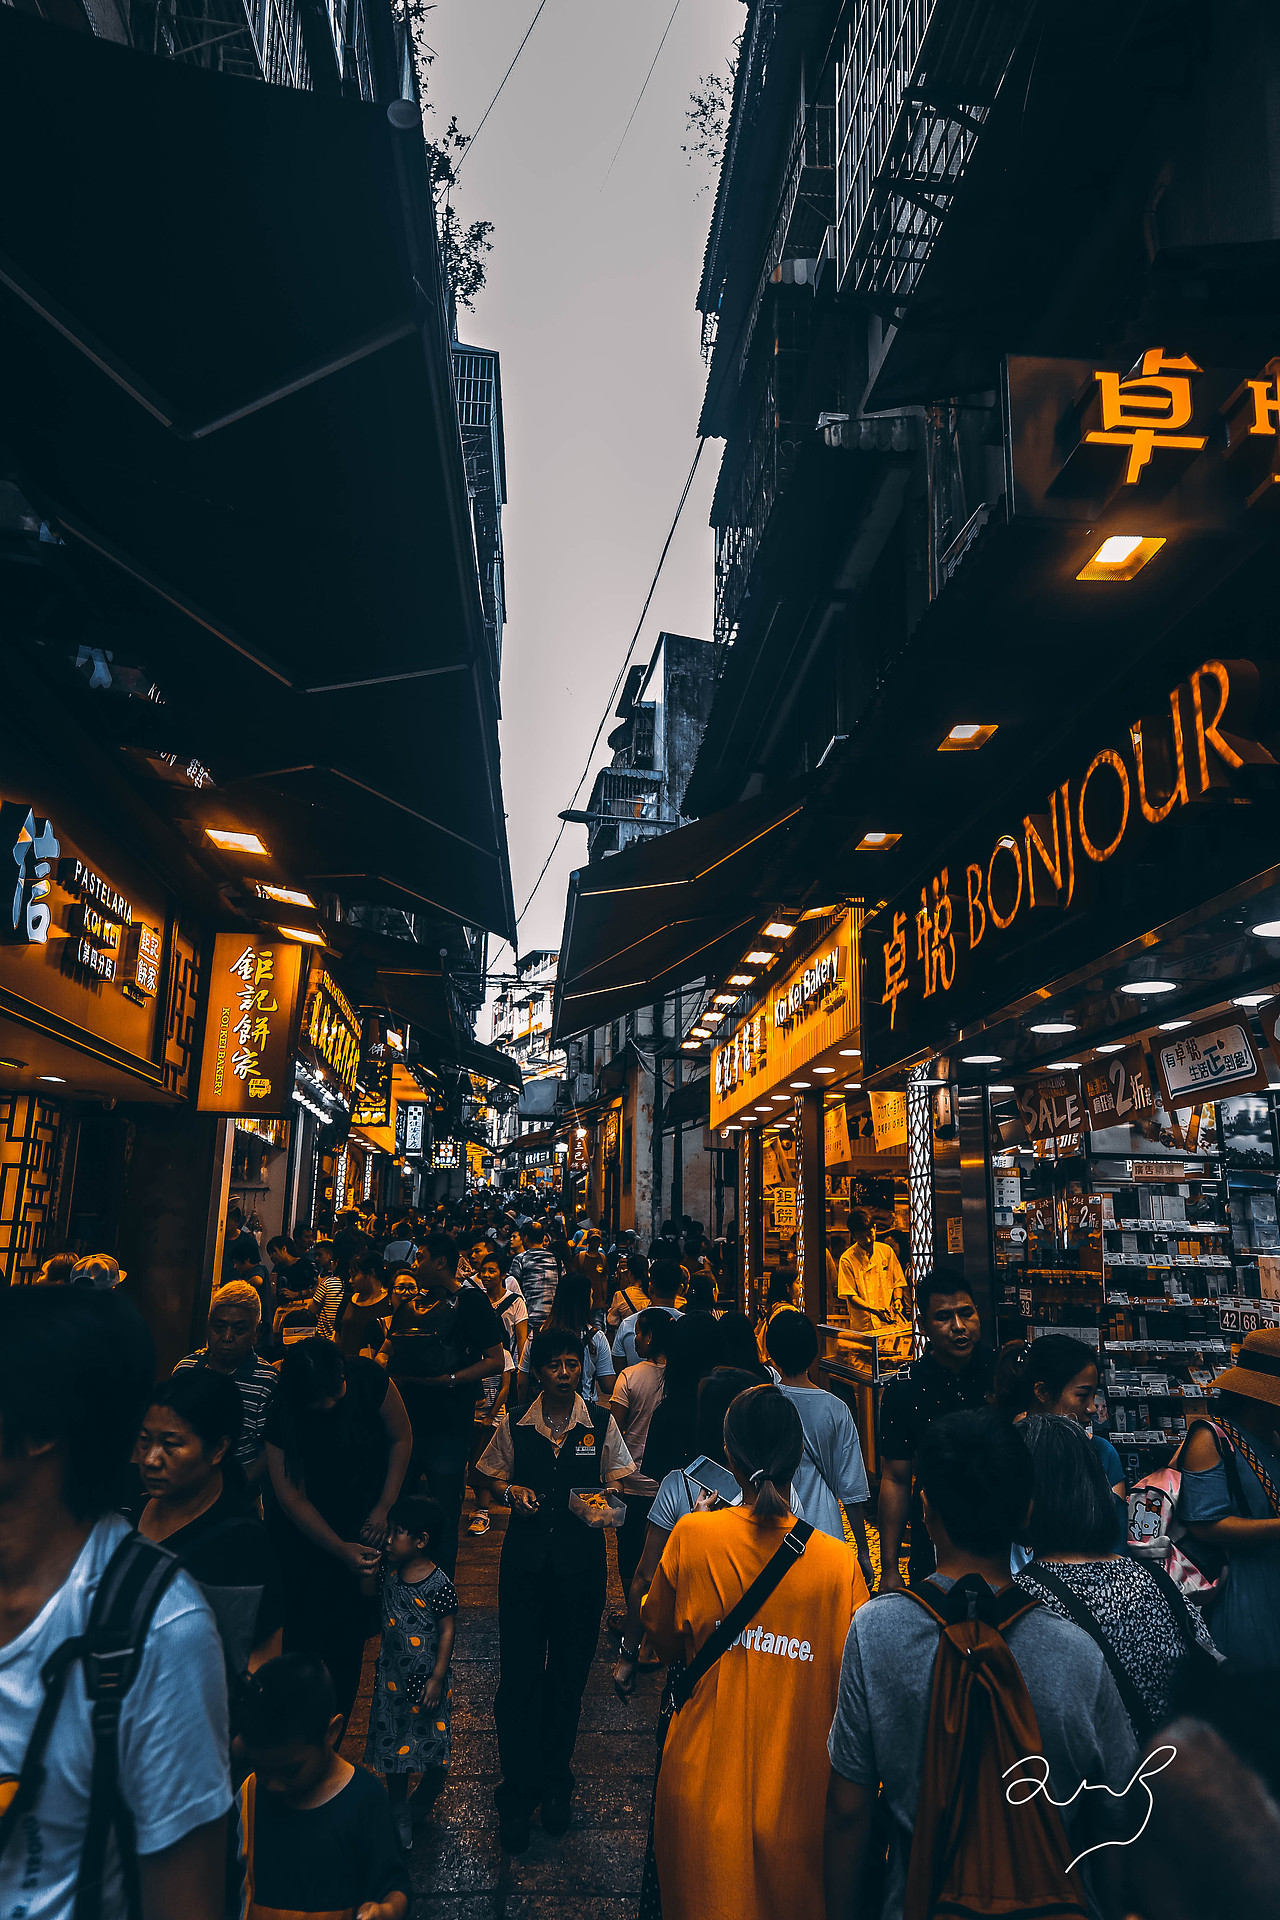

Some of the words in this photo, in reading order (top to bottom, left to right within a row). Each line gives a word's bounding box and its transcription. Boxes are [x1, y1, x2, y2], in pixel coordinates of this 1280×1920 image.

[967, 659, 1245, 950] BONJOUR
[74, 859, 132, 926] PASTELARIA
[83, 903, 102, 937] KOI
[774, 992, 788, 1028] Koi
[788, 982, 802, 1016] Kei
[803, 946, 839, 1002] Bakery
[219, 1007, 231, 1028] KOI
[229, 946, 278, 1080] 鉅記餅家
[217, 1029, 229, 1049] KEI
[213, 1050, 228, 1097] BAKERY
[1020, 1089, 1081, 1134] SALE
[1020, 1300, 1030, 1315] 39
[1222, 1312, 1237, 1329] 42
[1243, 1314, 1257, 1331] 68
